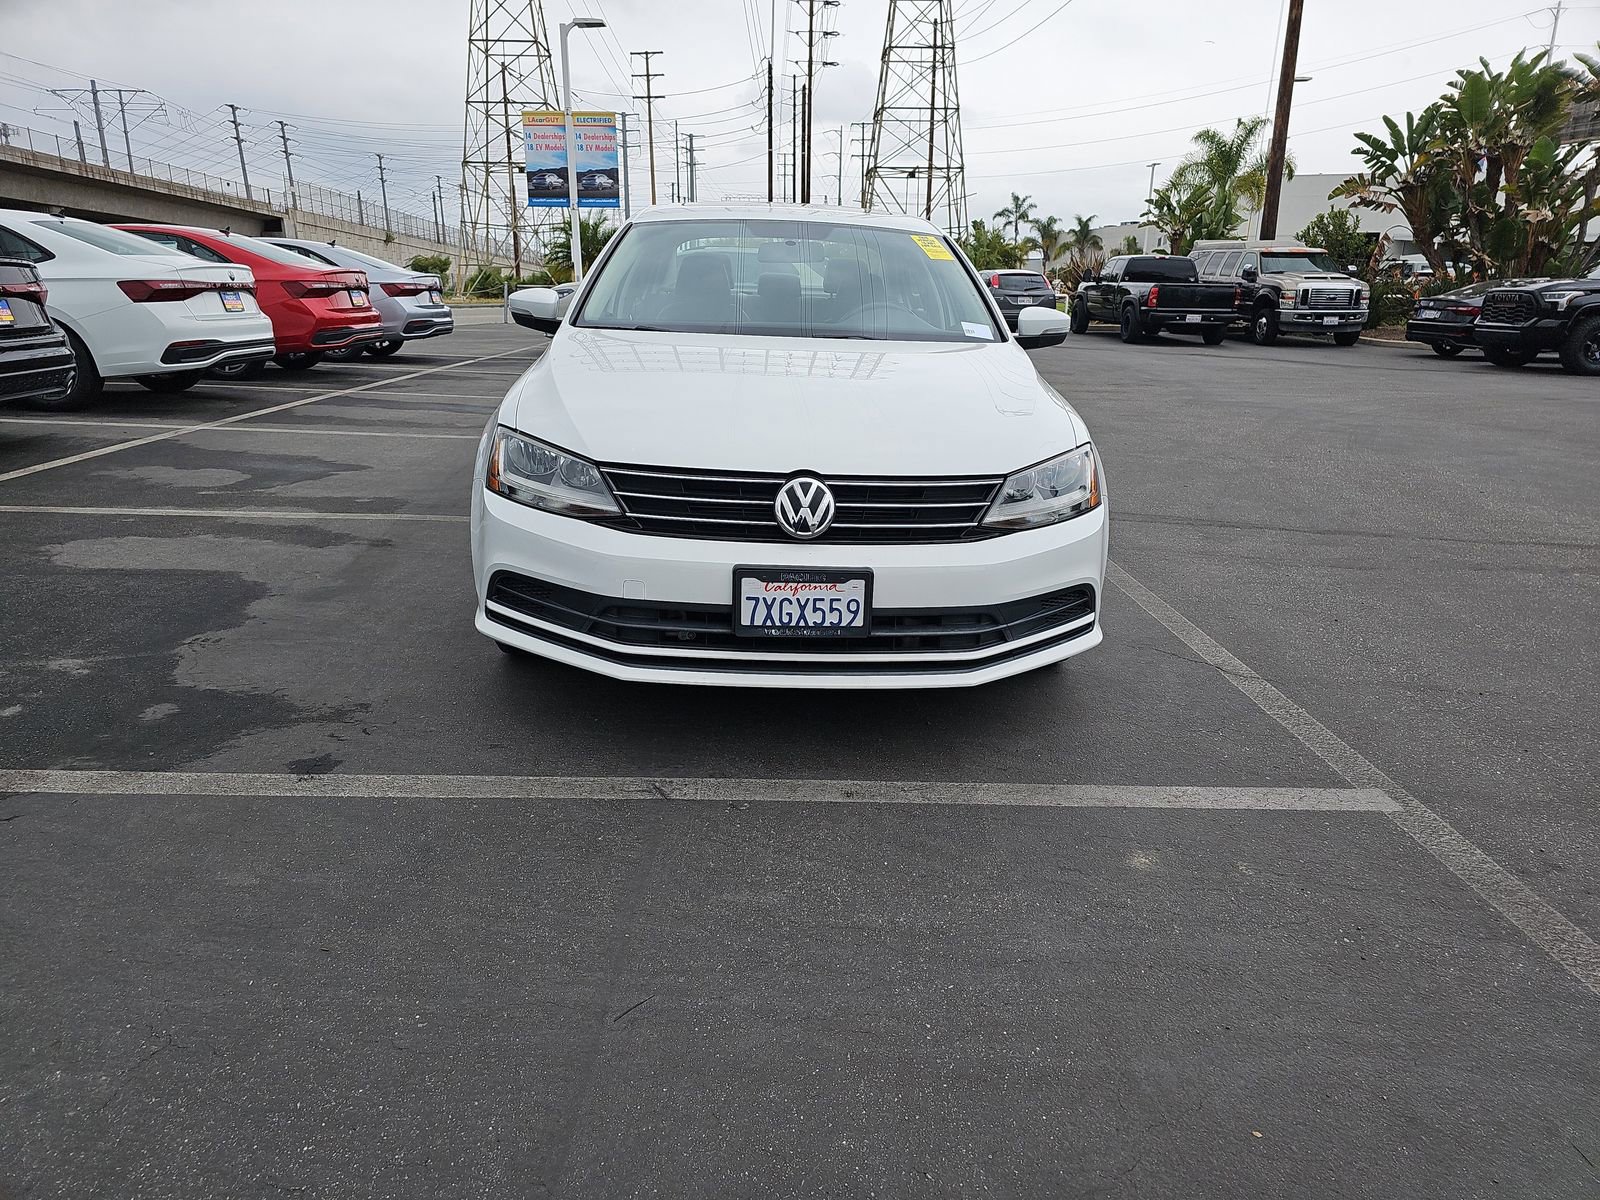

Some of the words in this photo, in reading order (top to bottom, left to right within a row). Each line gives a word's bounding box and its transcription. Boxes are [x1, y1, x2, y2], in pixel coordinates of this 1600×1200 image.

[525, 132, 532, 140] 14
[533, 132, 566, 142] Dealerships
[583, 132, 616, 143] Dealerships
[527, 143, 534, 151] 18
[764, 582, 846, 597] California
[745, 596, 860, 627] 7XGX559
